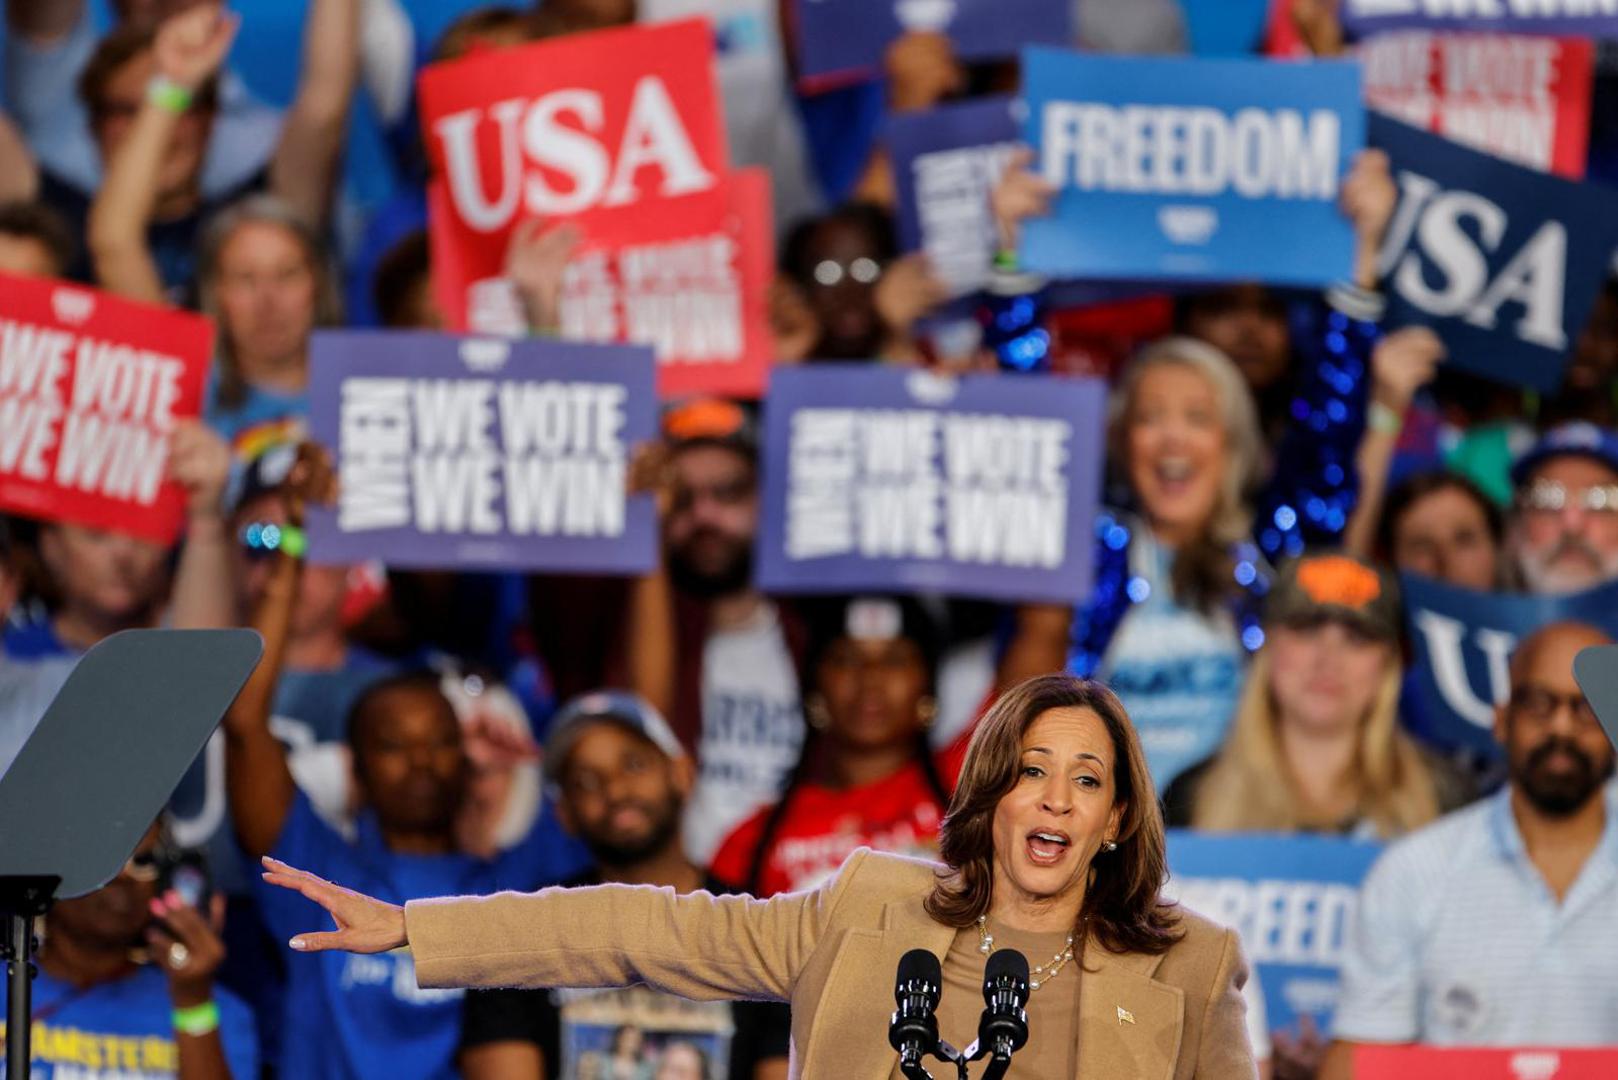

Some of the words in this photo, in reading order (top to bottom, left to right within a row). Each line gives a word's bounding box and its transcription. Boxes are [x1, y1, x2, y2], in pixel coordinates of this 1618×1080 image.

[435, 75, 717, 233] USA
[1042, 100, 1340, 201] FREEDOM
[72, 336, 186, 436] VOTE
[412, 378, 498, 452] WE
[498, 380, 628, 455] VOTE
[54, 408, 172, 506] WIN
[410, 451, 503, 533] WE
[503, 454, 626, 537] WIN
[854, 408, 942, 482] WE
[942, 411, 1073, 489] VOTE
[856, 483, 945, 559] WE
[945, 486, 1068, 571] WIN
